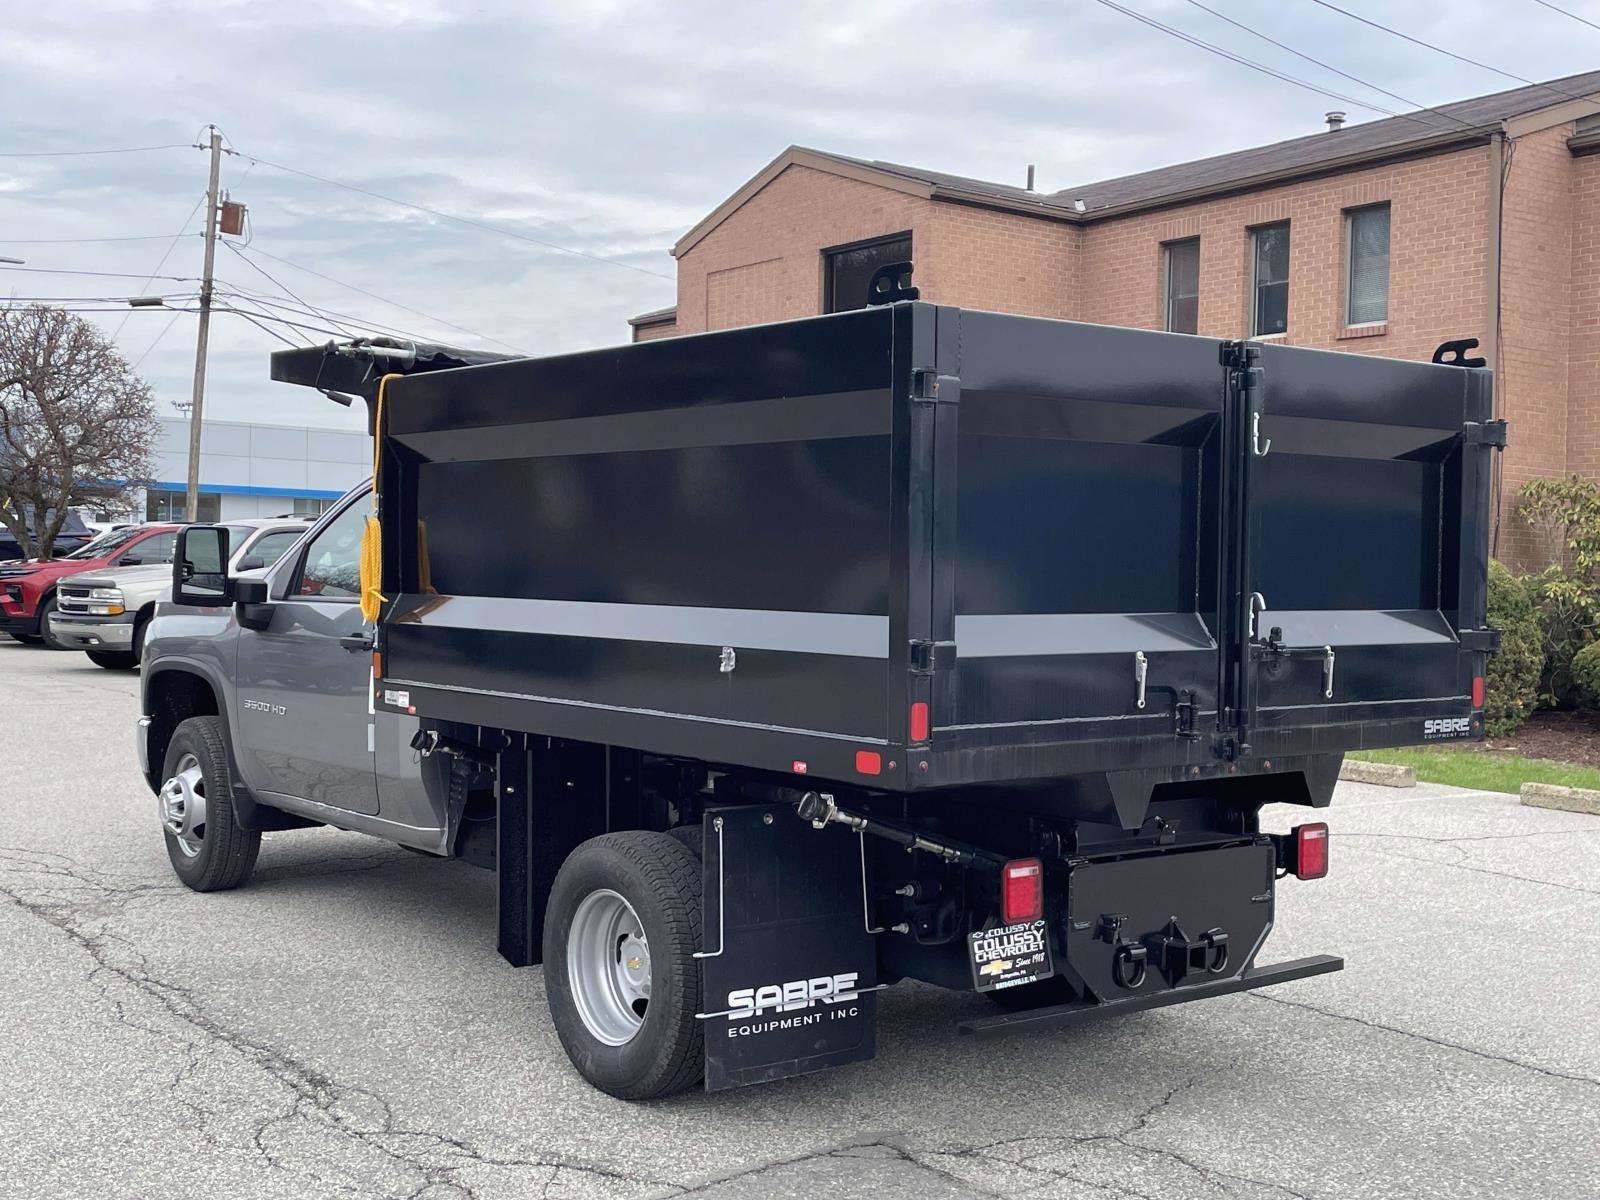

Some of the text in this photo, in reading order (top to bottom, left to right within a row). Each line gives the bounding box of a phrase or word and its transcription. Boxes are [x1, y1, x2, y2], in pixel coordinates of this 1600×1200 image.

[244, 699, 287, 716] 3500 HD
[1424, 718, 1470, 734] SABRE
[988, 922, 1031, 938] COLUSSY
[973, 928, 1044, 954] COLUSSY
[975, 940, 1045, 963] CHEVROLET
[1015, 957, 1031, 968] Since
[728, 972, 858, 1020] SABRE
[728, 1007, 859, 1038] EQUIPMENT INC
